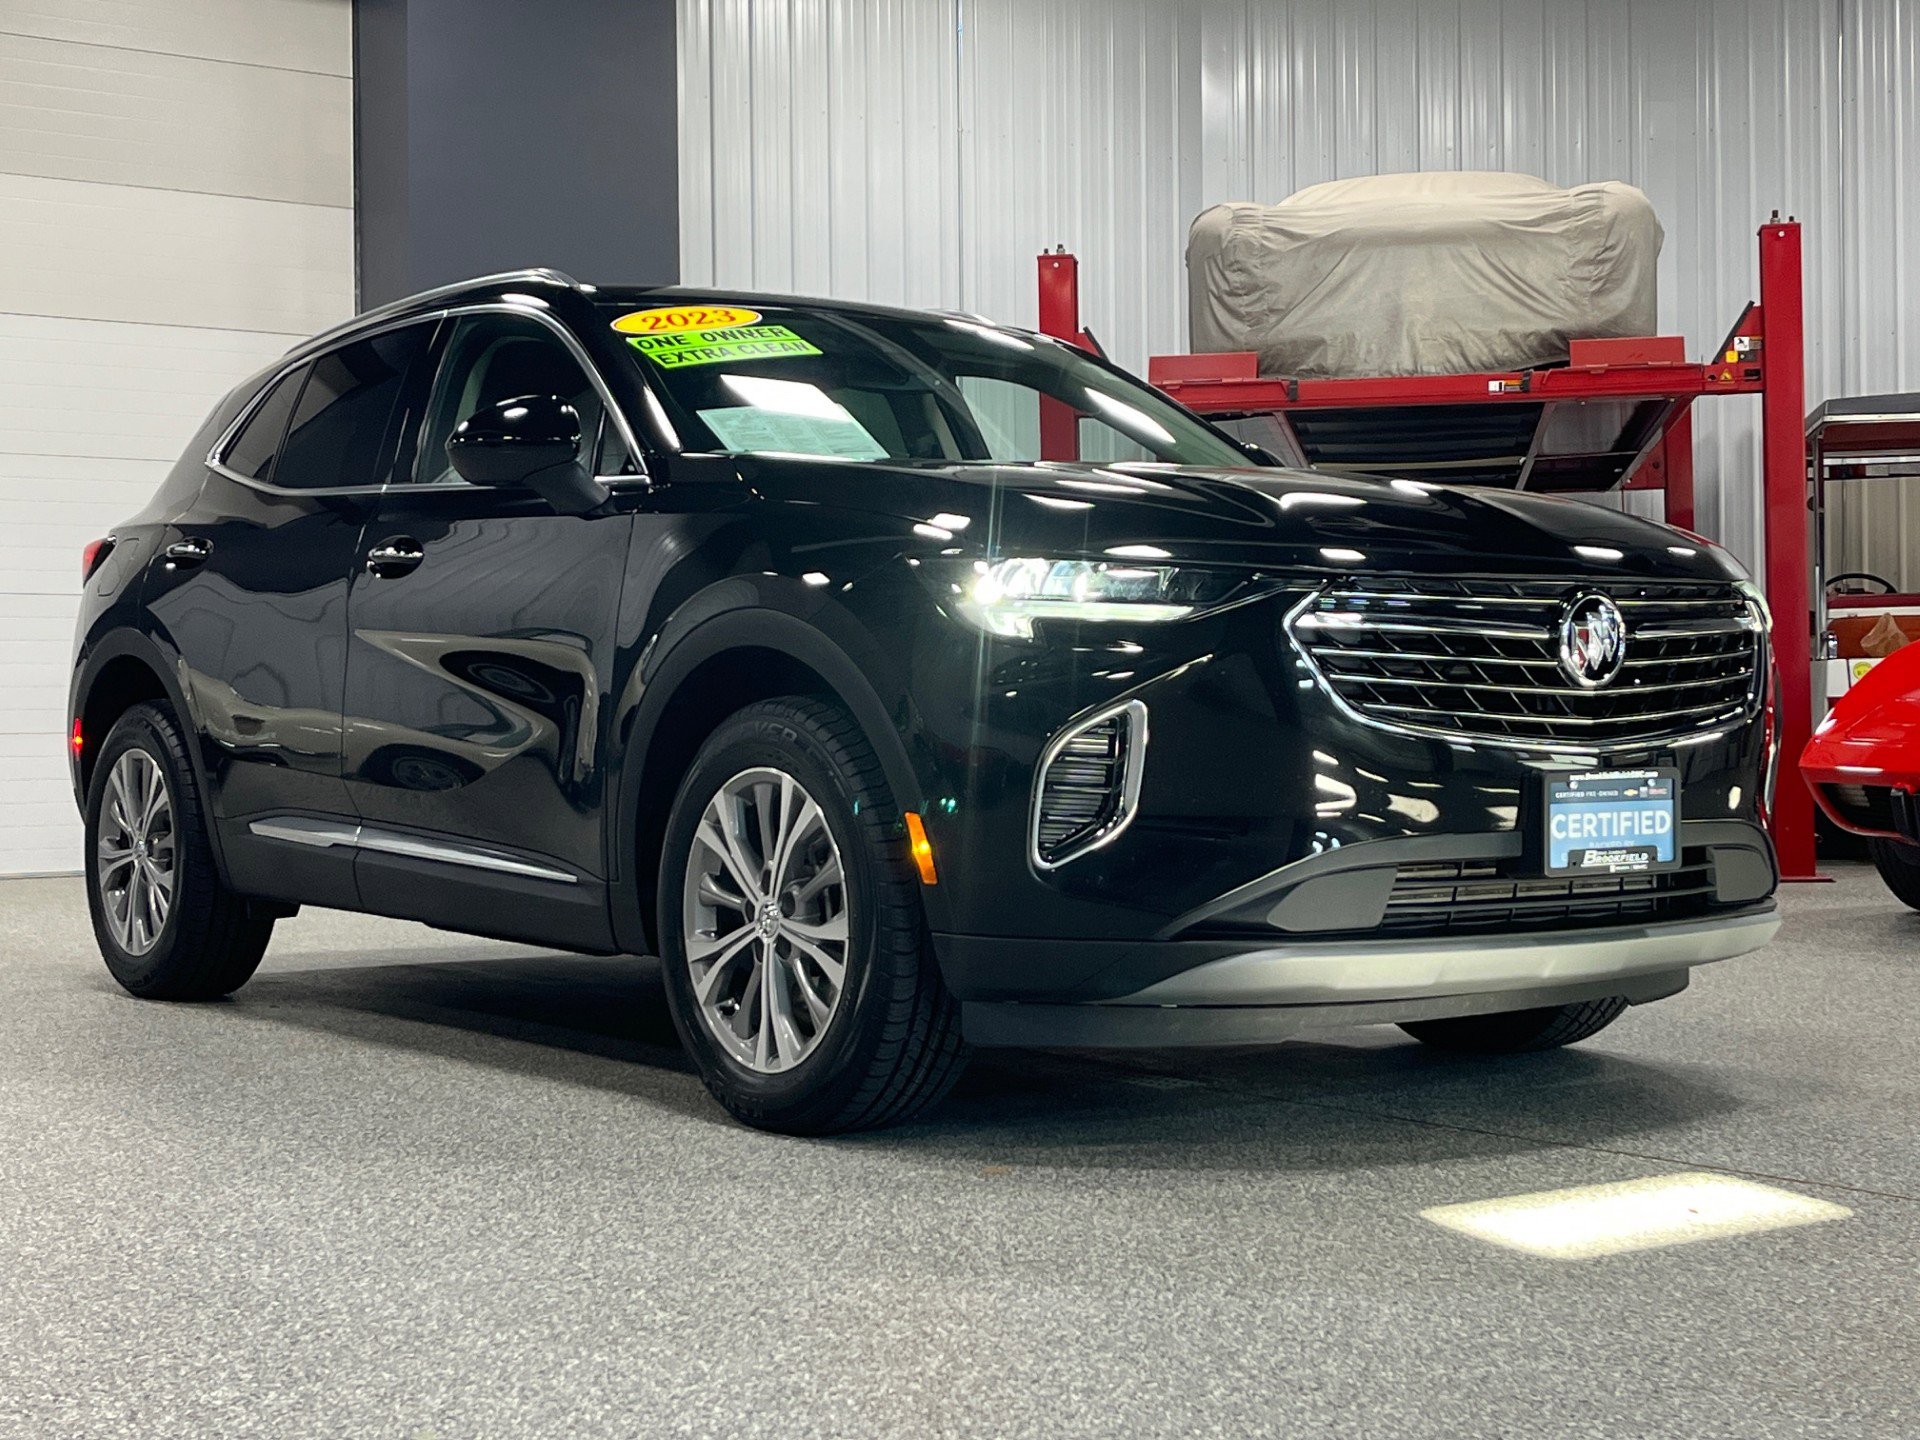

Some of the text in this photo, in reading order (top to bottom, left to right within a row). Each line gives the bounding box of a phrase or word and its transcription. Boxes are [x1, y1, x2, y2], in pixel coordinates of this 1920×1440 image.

[642, 309, 737, 331] 2023
[637, 327, 788, 350] ONE OWNER
[659, 342, 811, 366] EXTRA CLEAN
[1551, 810, 1672, 839] CERTIFIED
